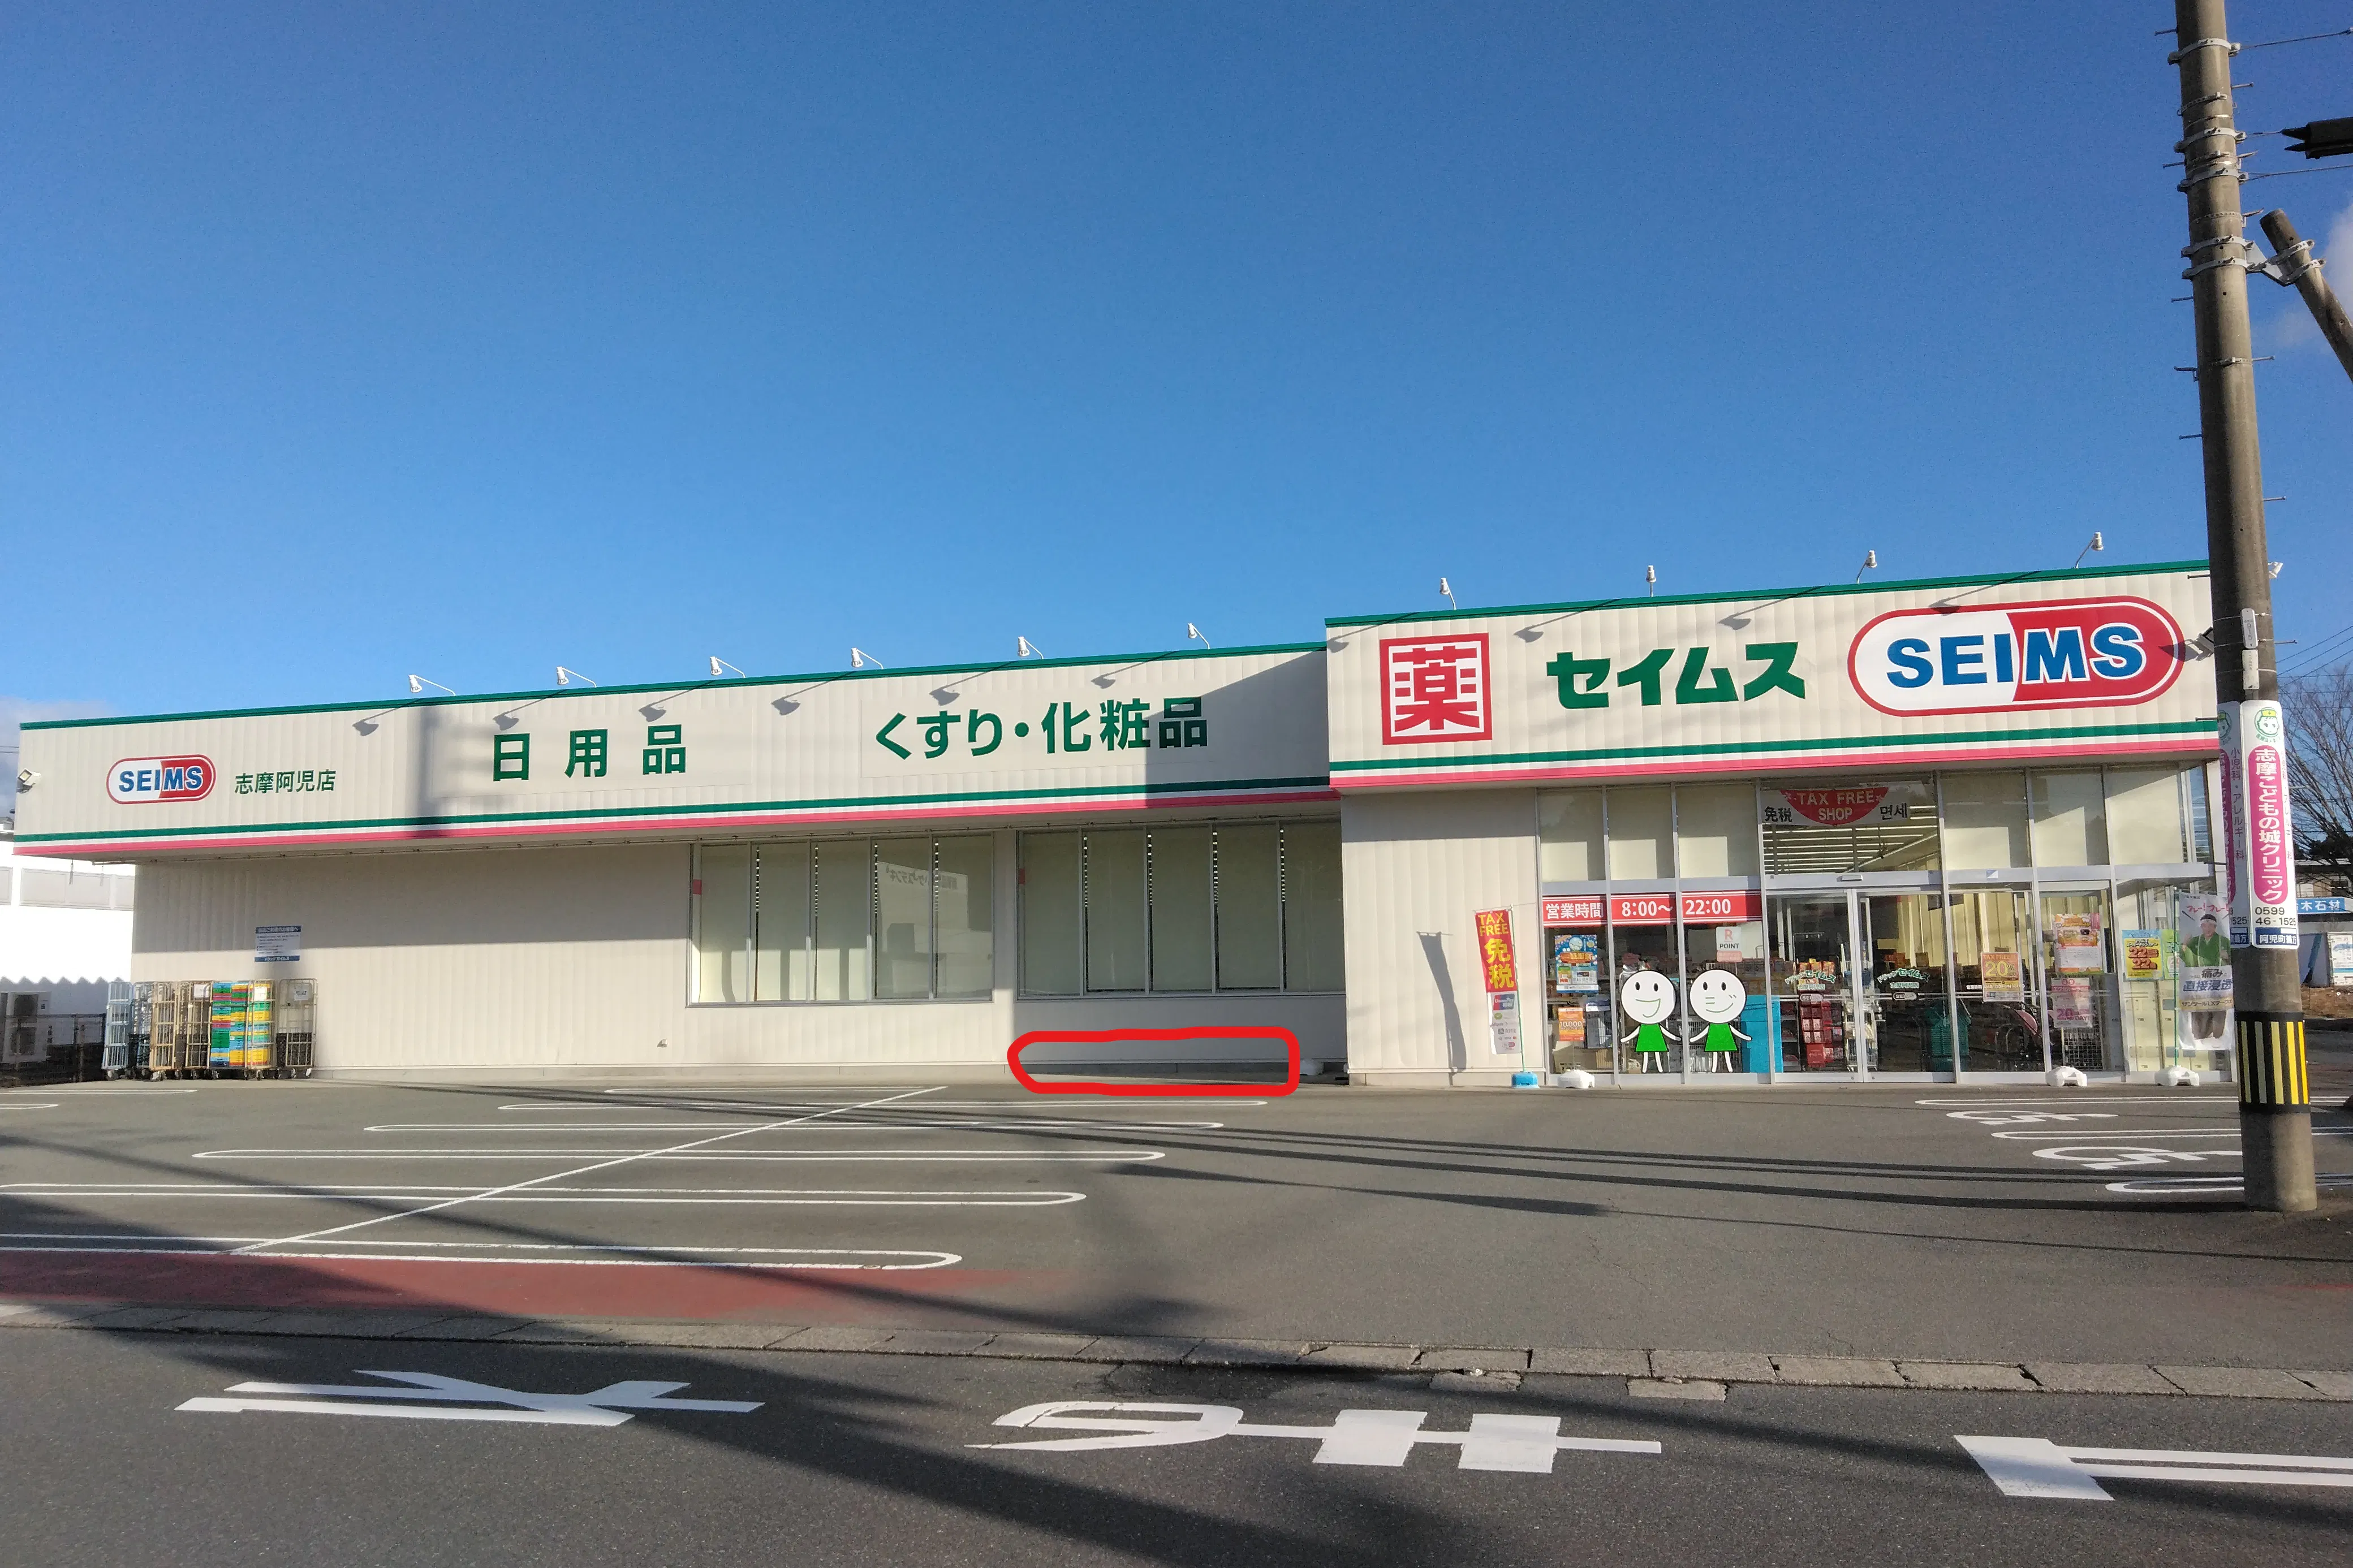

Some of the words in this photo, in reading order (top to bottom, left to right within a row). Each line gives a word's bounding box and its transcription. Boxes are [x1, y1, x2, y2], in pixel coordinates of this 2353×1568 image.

[1886, 621, 2147, 689] SEIMS
[1546, 641, 1806, 710] セイムス
[1392, 645, 1480, 733] 薬
[875, 696, 1208, 760] くすり・化粧品
[493, 724, 686, 781] 日用品
[118, 766, 204, 792] SEIMS
[235, 769, 337, 794] 志摩阿児店
[1797, 792, 1829, 806] TAX
[1837, 790, 1876, 805] FREE
[1764, 806, 1792, 823] 免税
[1818, 807, 1852, 820] SHOP
[1880, 802, 1908, 820] 면세
[2255, 748, 2283, 901] 志摩こどもの城クリニック
[1478, 912, 1505, 925] TAX
[1546, 902, 1604, 919] 営業時間
[1685, 899, 1731, 915] 22:00
[2296, 900, 2341, 912] 木石材
[1479, 923, 1509, 937] FREE
[1484, 938, 1514, 989] 免税
